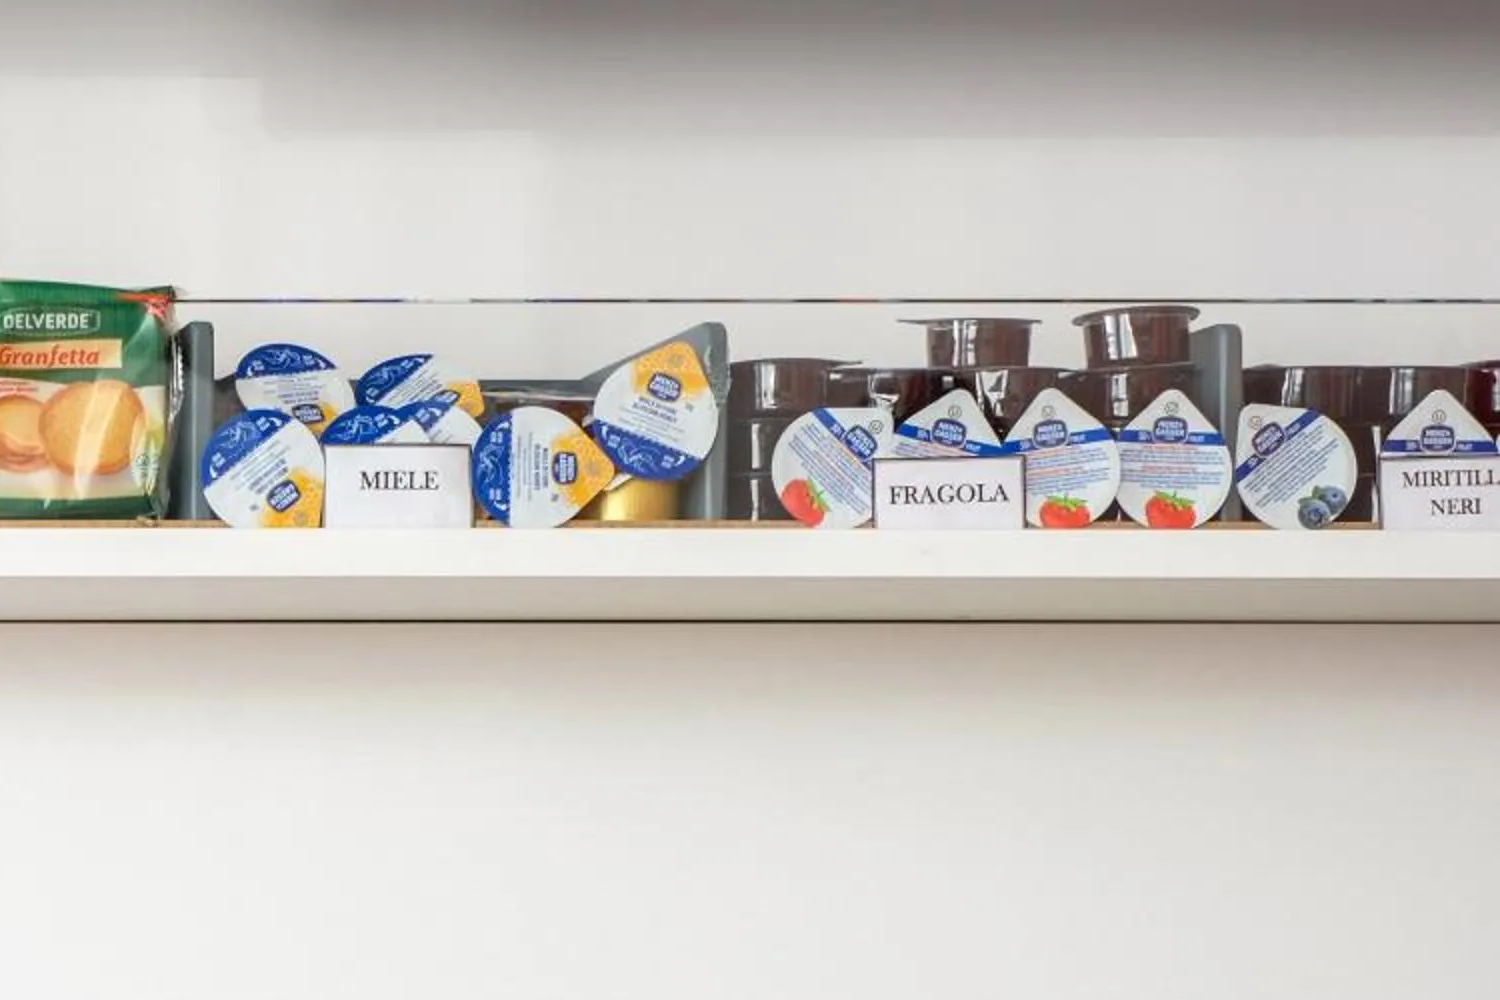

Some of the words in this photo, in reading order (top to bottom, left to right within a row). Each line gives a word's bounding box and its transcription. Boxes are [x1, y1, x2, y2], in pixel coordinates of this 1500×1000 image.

[3, 312, 90, 330] DELVERDE
[360, 470, 440, 490] MIELE
[890, 482, 1010, 505] FRAGOLA
[1430, 497, 1482, 516] NERI
